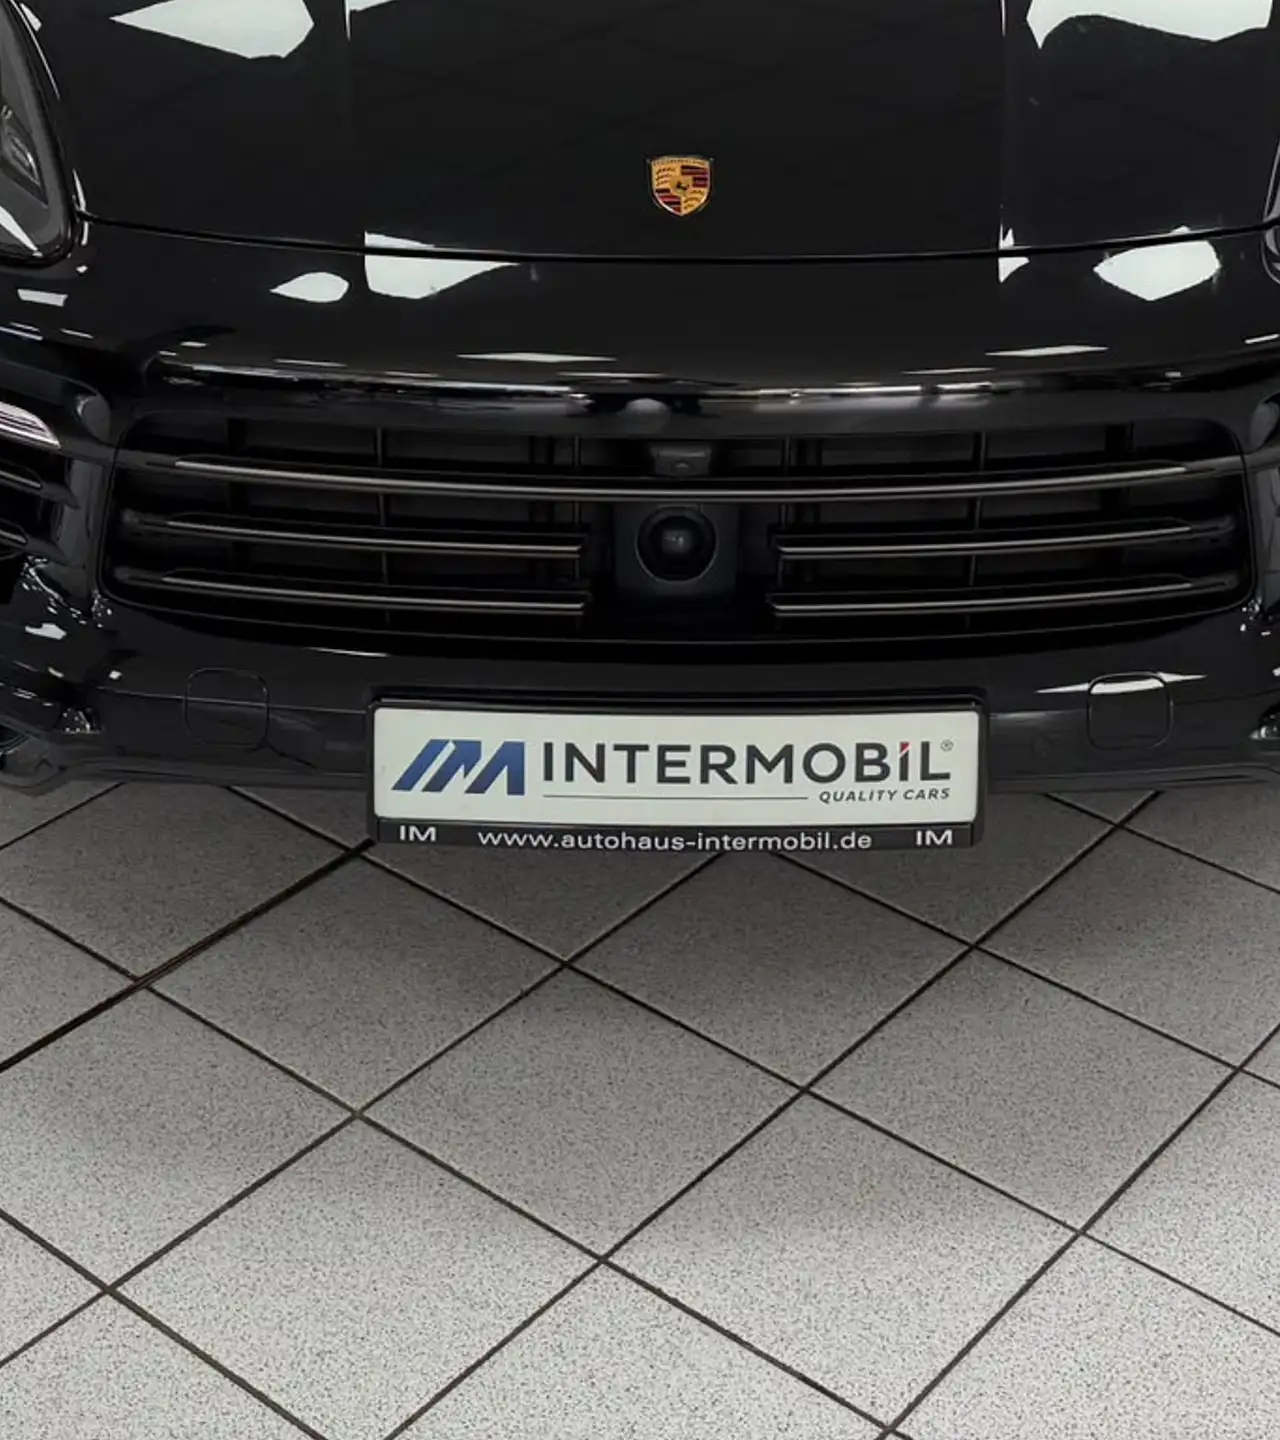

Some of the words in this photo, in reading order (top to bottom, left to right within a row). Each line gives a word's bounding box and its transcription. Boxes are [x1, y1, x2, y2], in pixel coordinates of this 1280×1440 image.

[543, 741, 952, 785] INTERMOBIL
[818, 788, 898, 804] QUALITY
[902, 787, 951, 801] CARS
[399, 825, 437, 842] IM
[477, 831, 872, 851] www.autohaus-intermobil.de
[916, 829, 953, 846] IM
